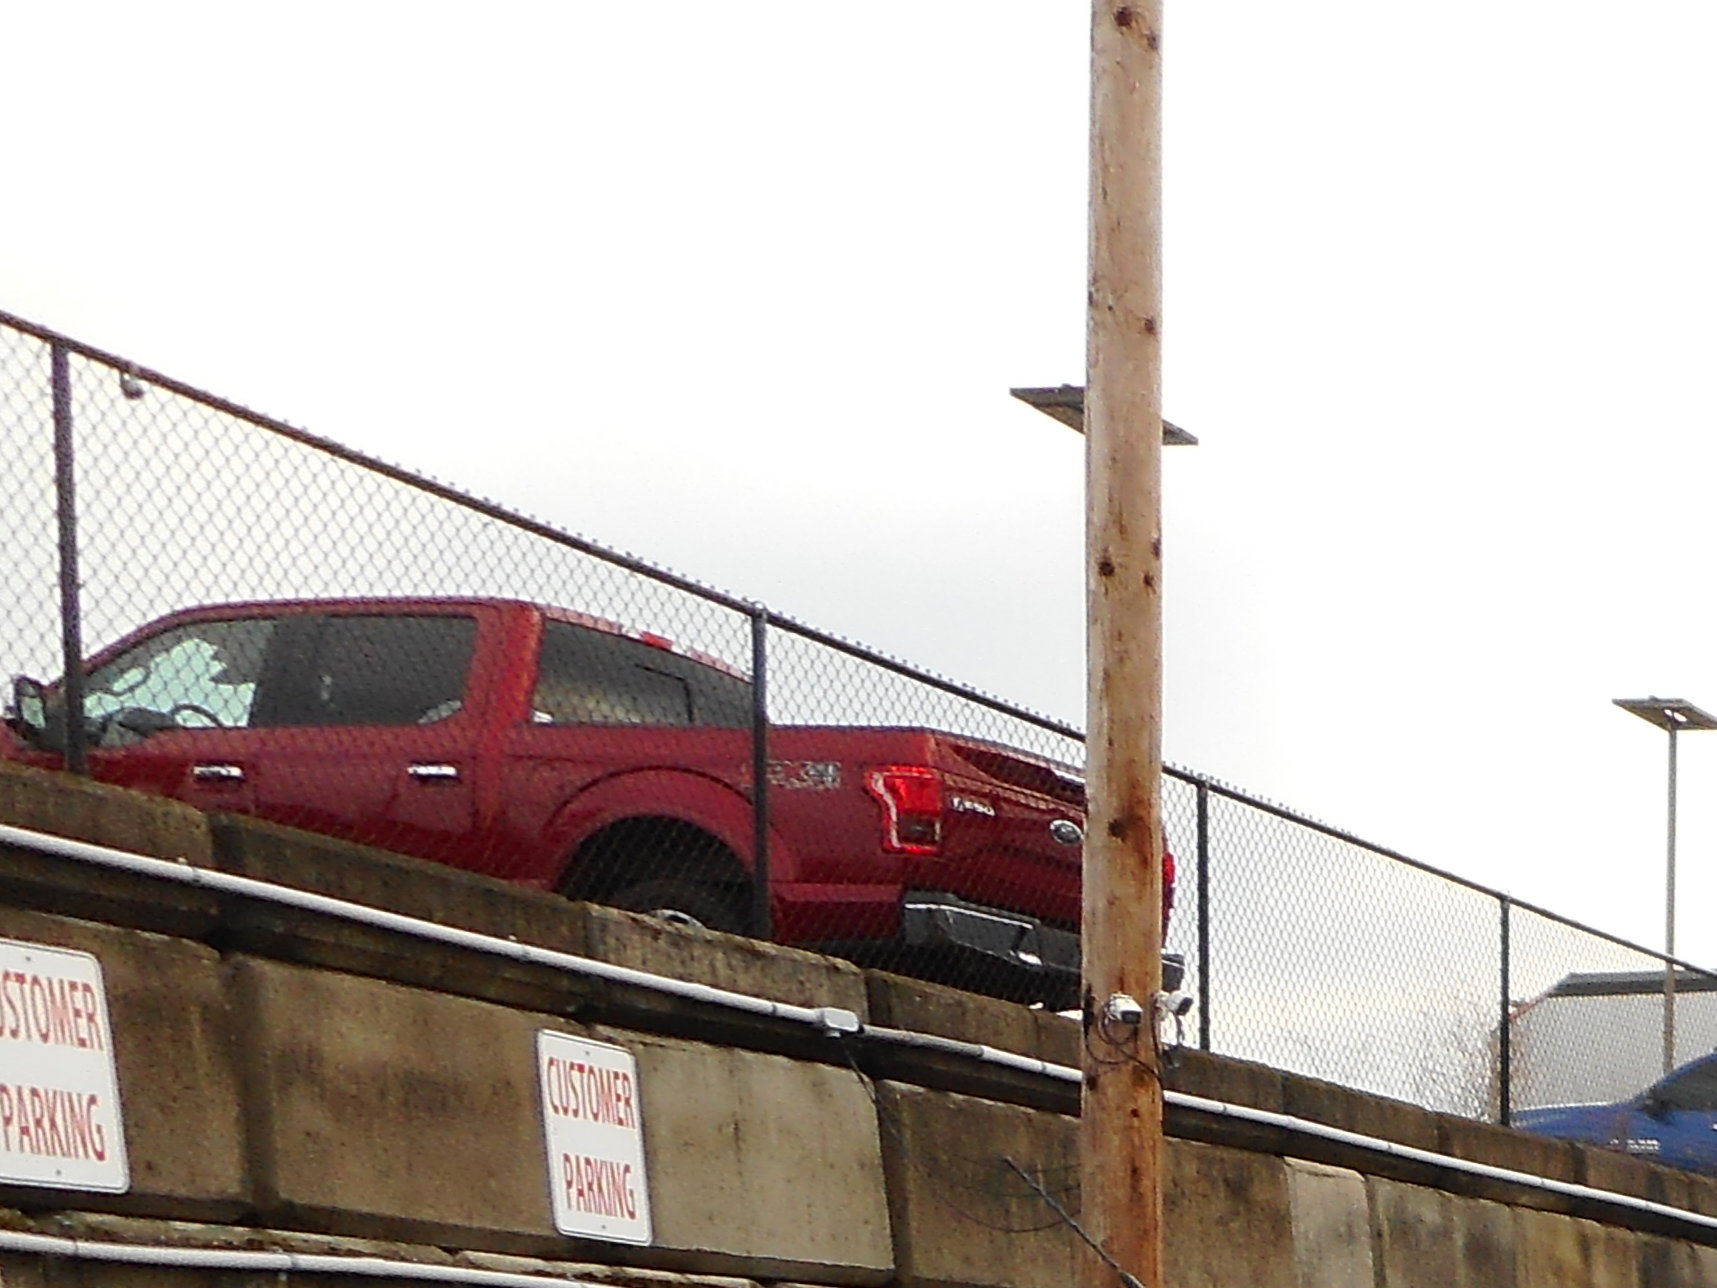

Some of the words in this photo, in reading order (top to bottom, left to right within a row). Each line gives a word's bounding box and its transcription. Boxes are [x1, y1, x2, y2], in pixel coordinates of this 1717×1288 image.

[0, 970, 104, 1052] STOMER
[0, 1083, 107, 1162] PARKING
[547, 1056, 636, 1130] CUSTOMER
[563, 1152, 637, 1221] PARKING
